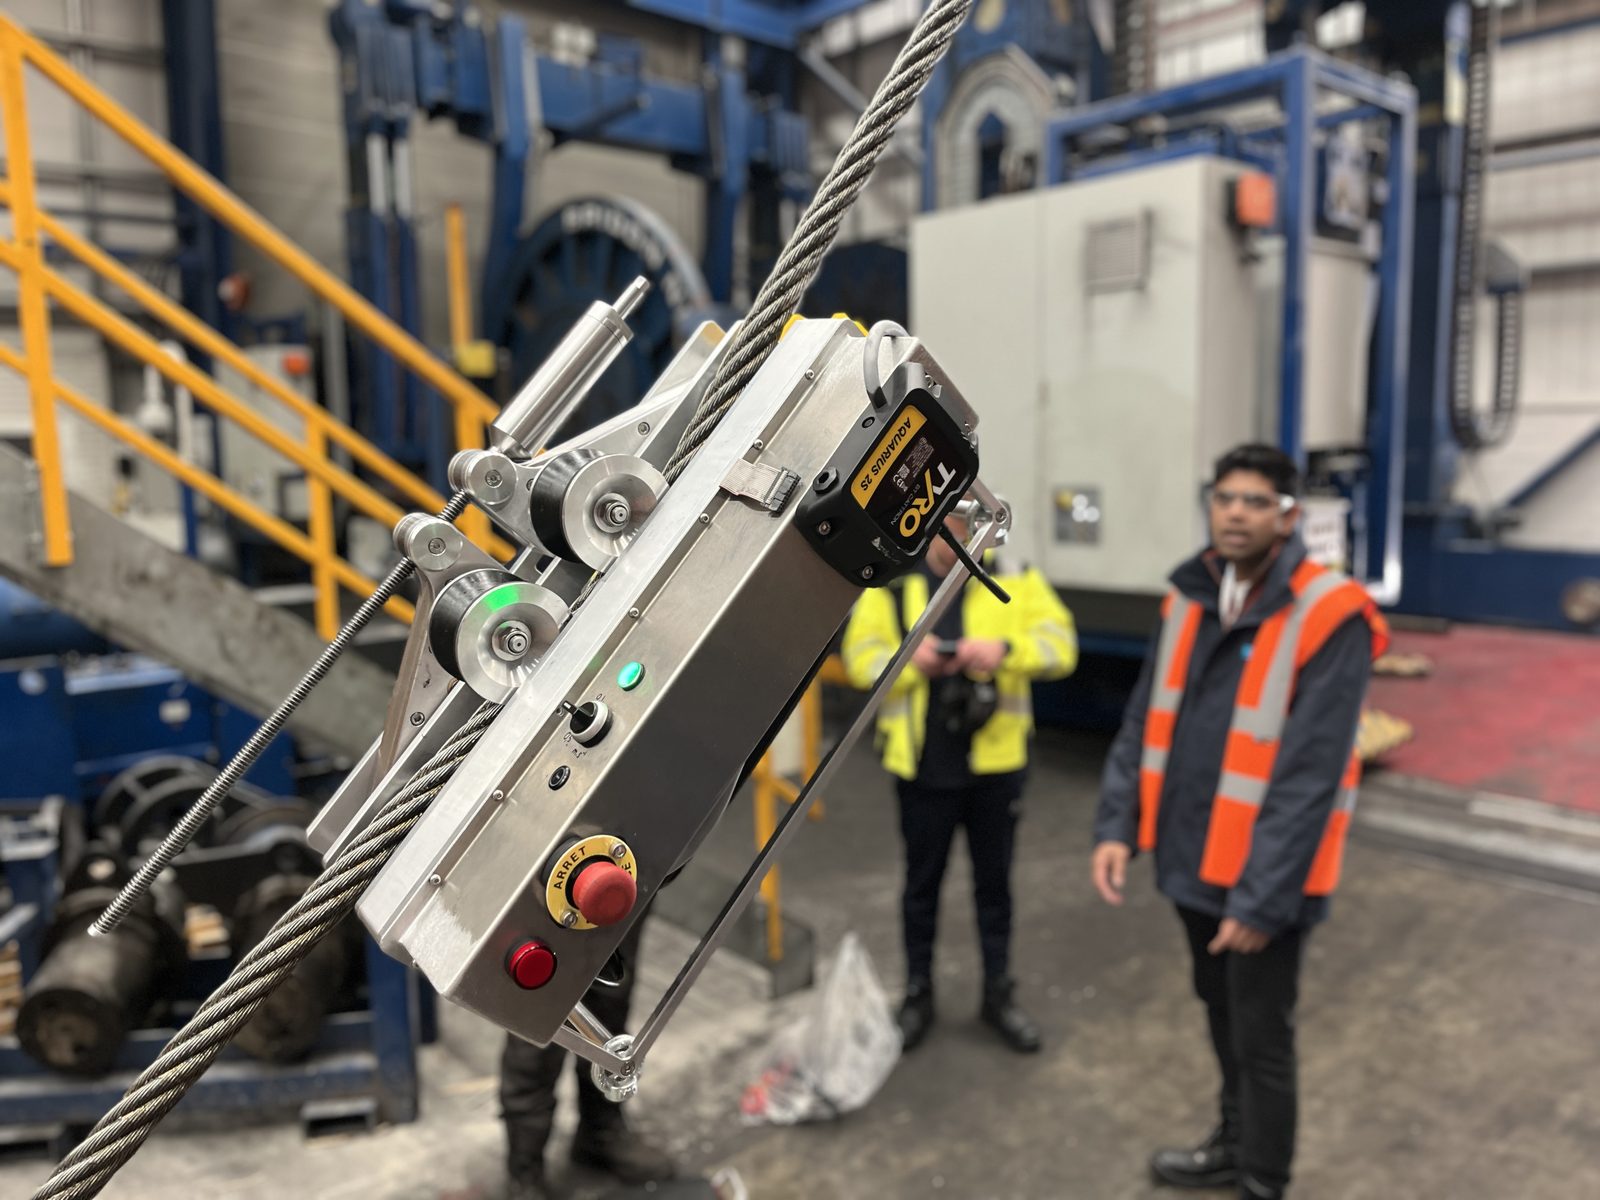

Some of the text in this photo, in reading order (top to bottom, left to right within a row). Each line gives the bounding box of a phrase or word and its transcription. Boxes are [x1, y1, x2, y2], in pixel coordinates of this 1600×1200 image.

[860, 416, 911, 491] AQUARIUS 2S
[900, 462, 957, 538] TYRO
[553, 845, 587, 890] ARRET
